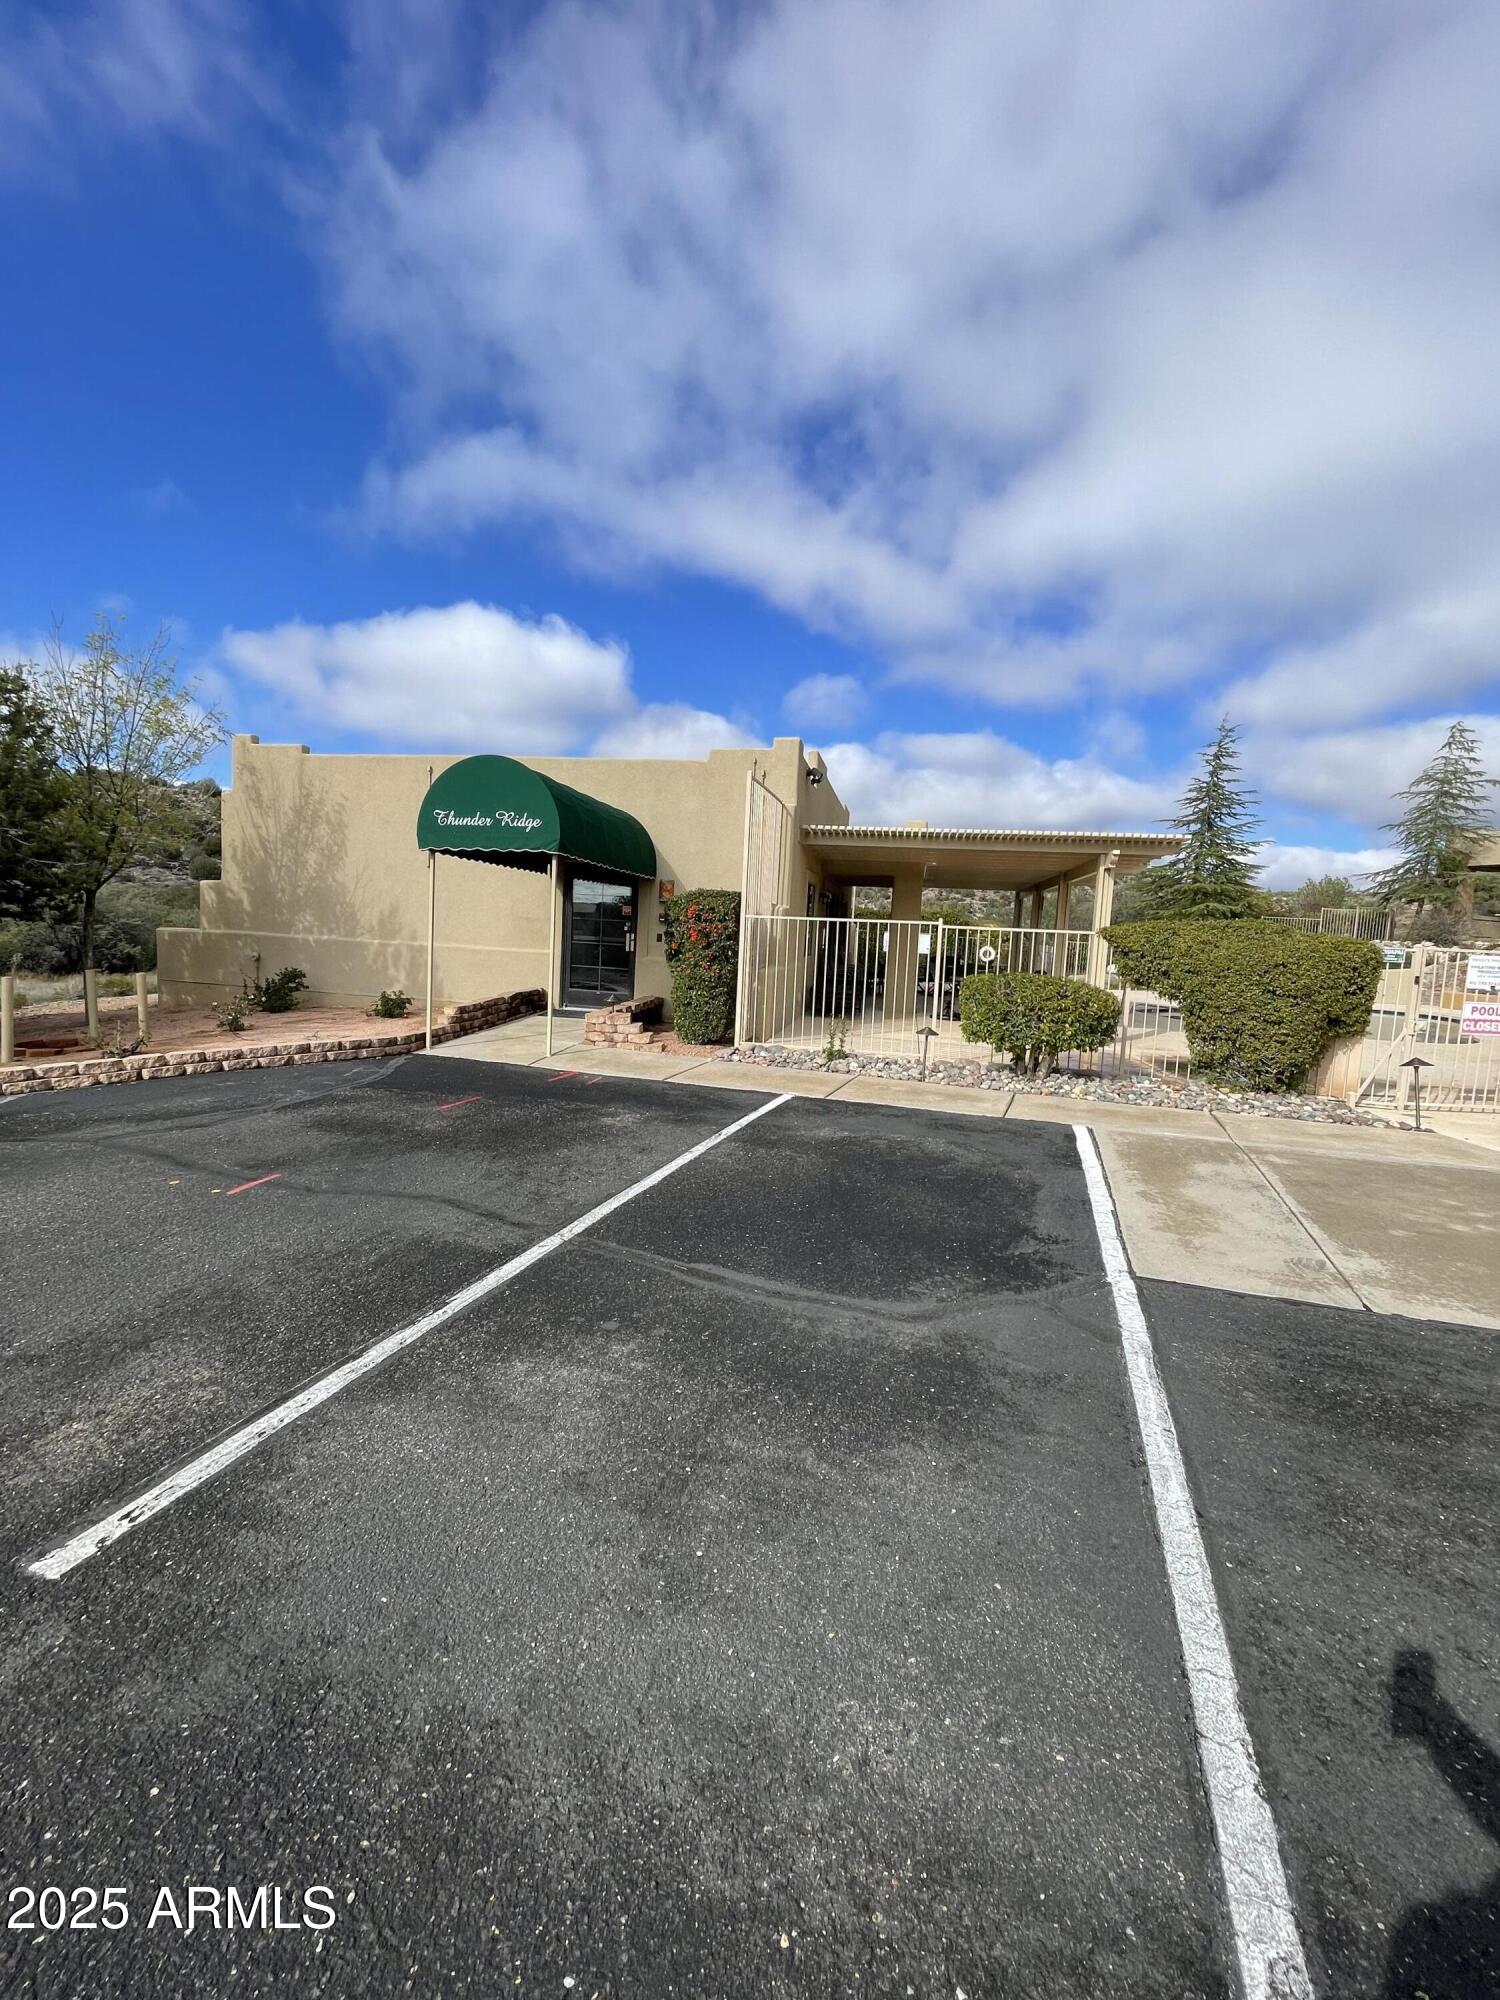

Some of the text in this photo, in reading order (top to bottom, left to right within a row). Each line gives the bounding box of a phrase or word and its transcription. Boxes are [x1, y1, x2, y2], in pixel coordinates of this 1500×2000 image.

[434, 809, 542, 832] Thunder Ridge
[1471, 1006, 1500, 1017] POOL
[1463, 1021, 1500, 1032] CLOSE
